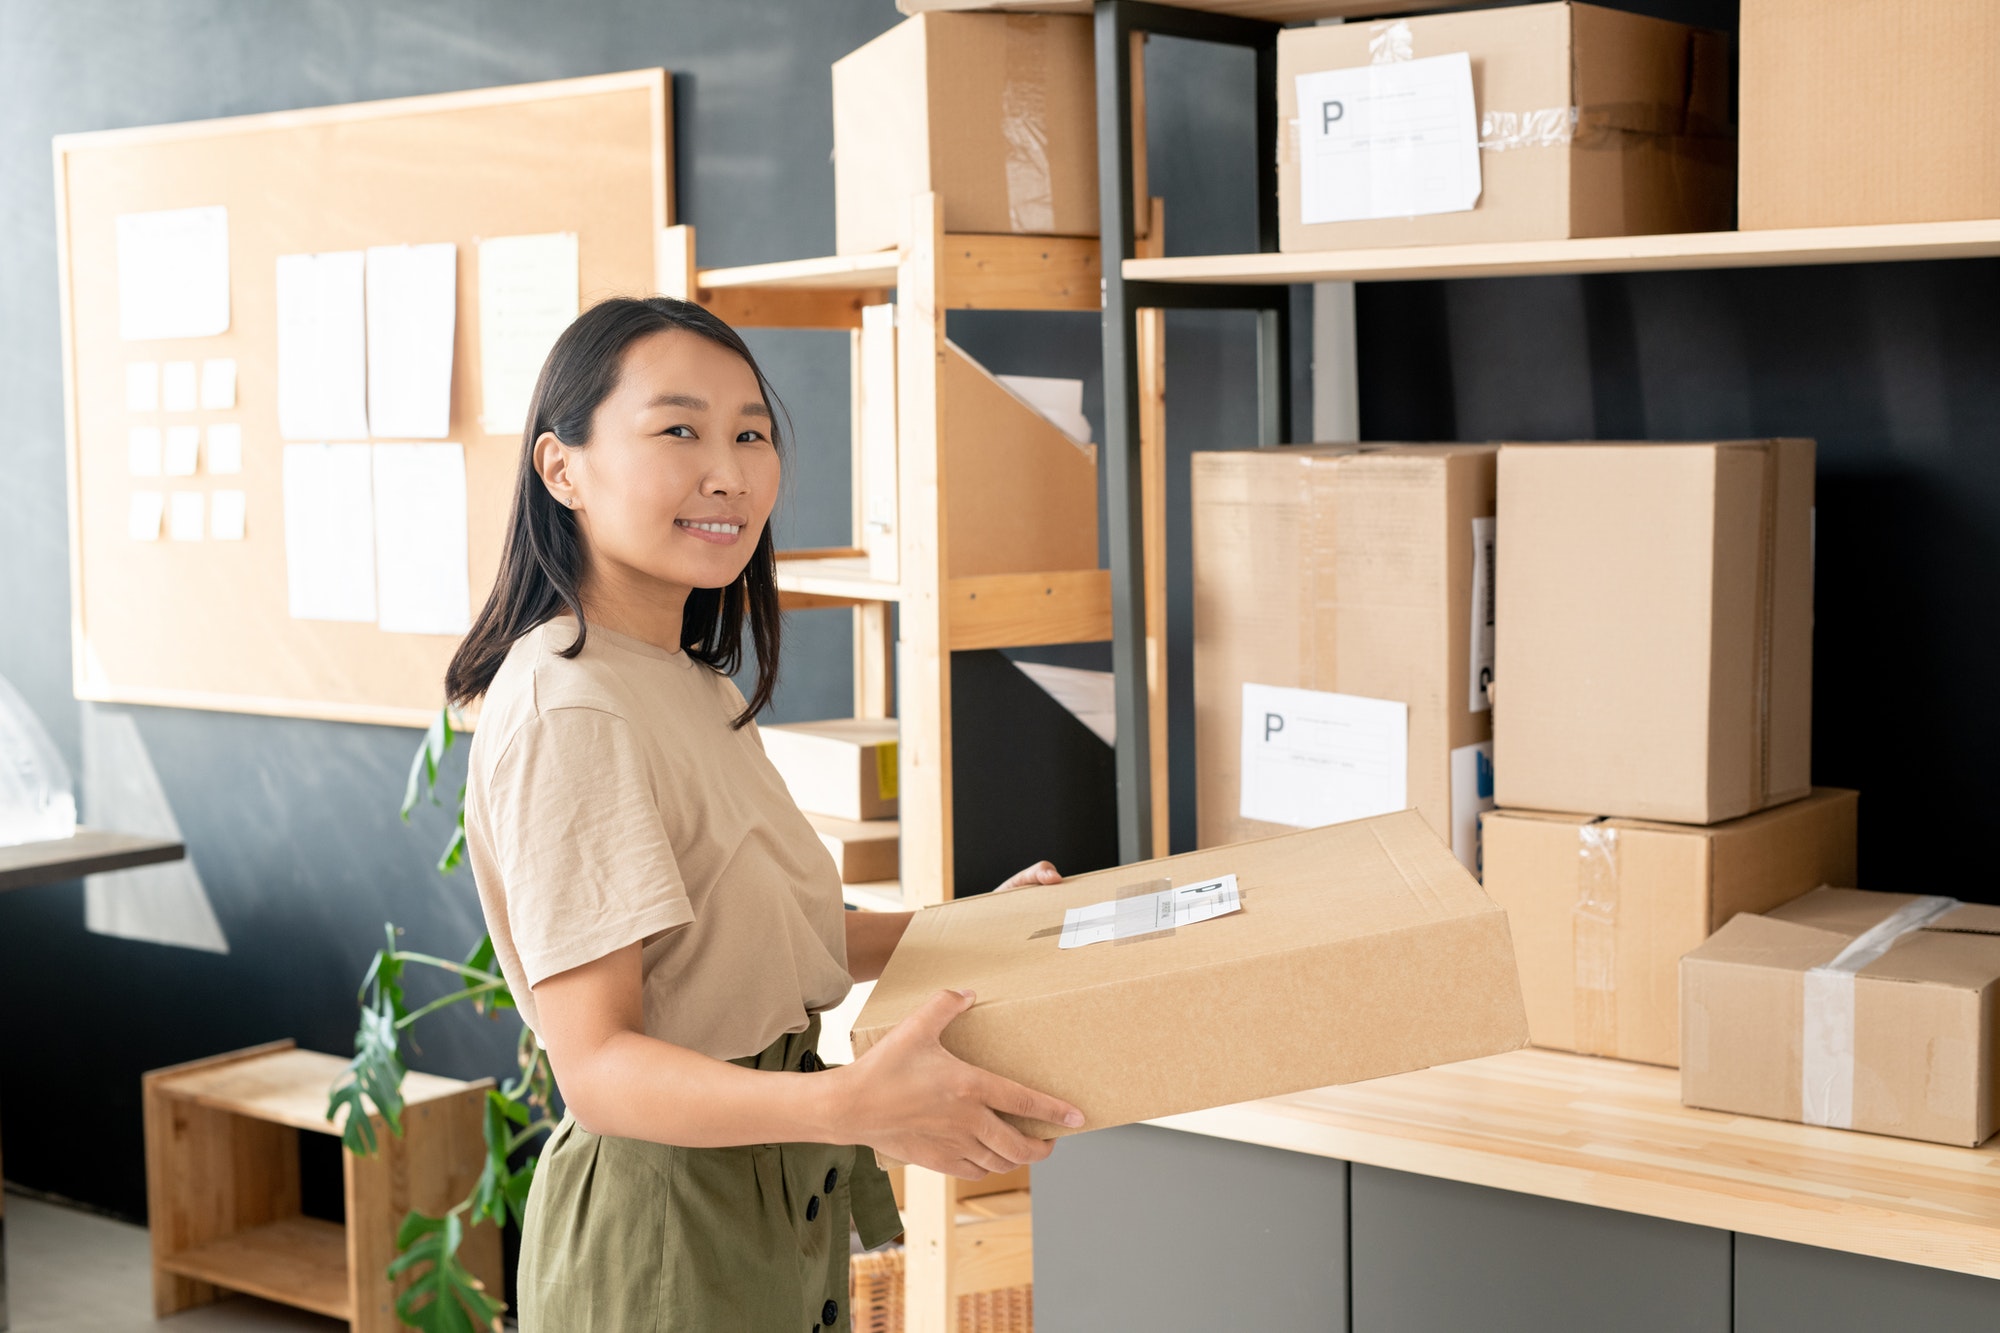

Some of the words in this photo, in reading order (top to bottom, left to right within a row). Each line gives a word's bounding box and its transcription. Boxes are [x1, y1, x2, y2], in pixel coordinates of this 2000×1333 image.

[1322, 100, 1344, 135] P
[1264, 712, 1284, 742] P
[1180, 883, 1222, 894] P
